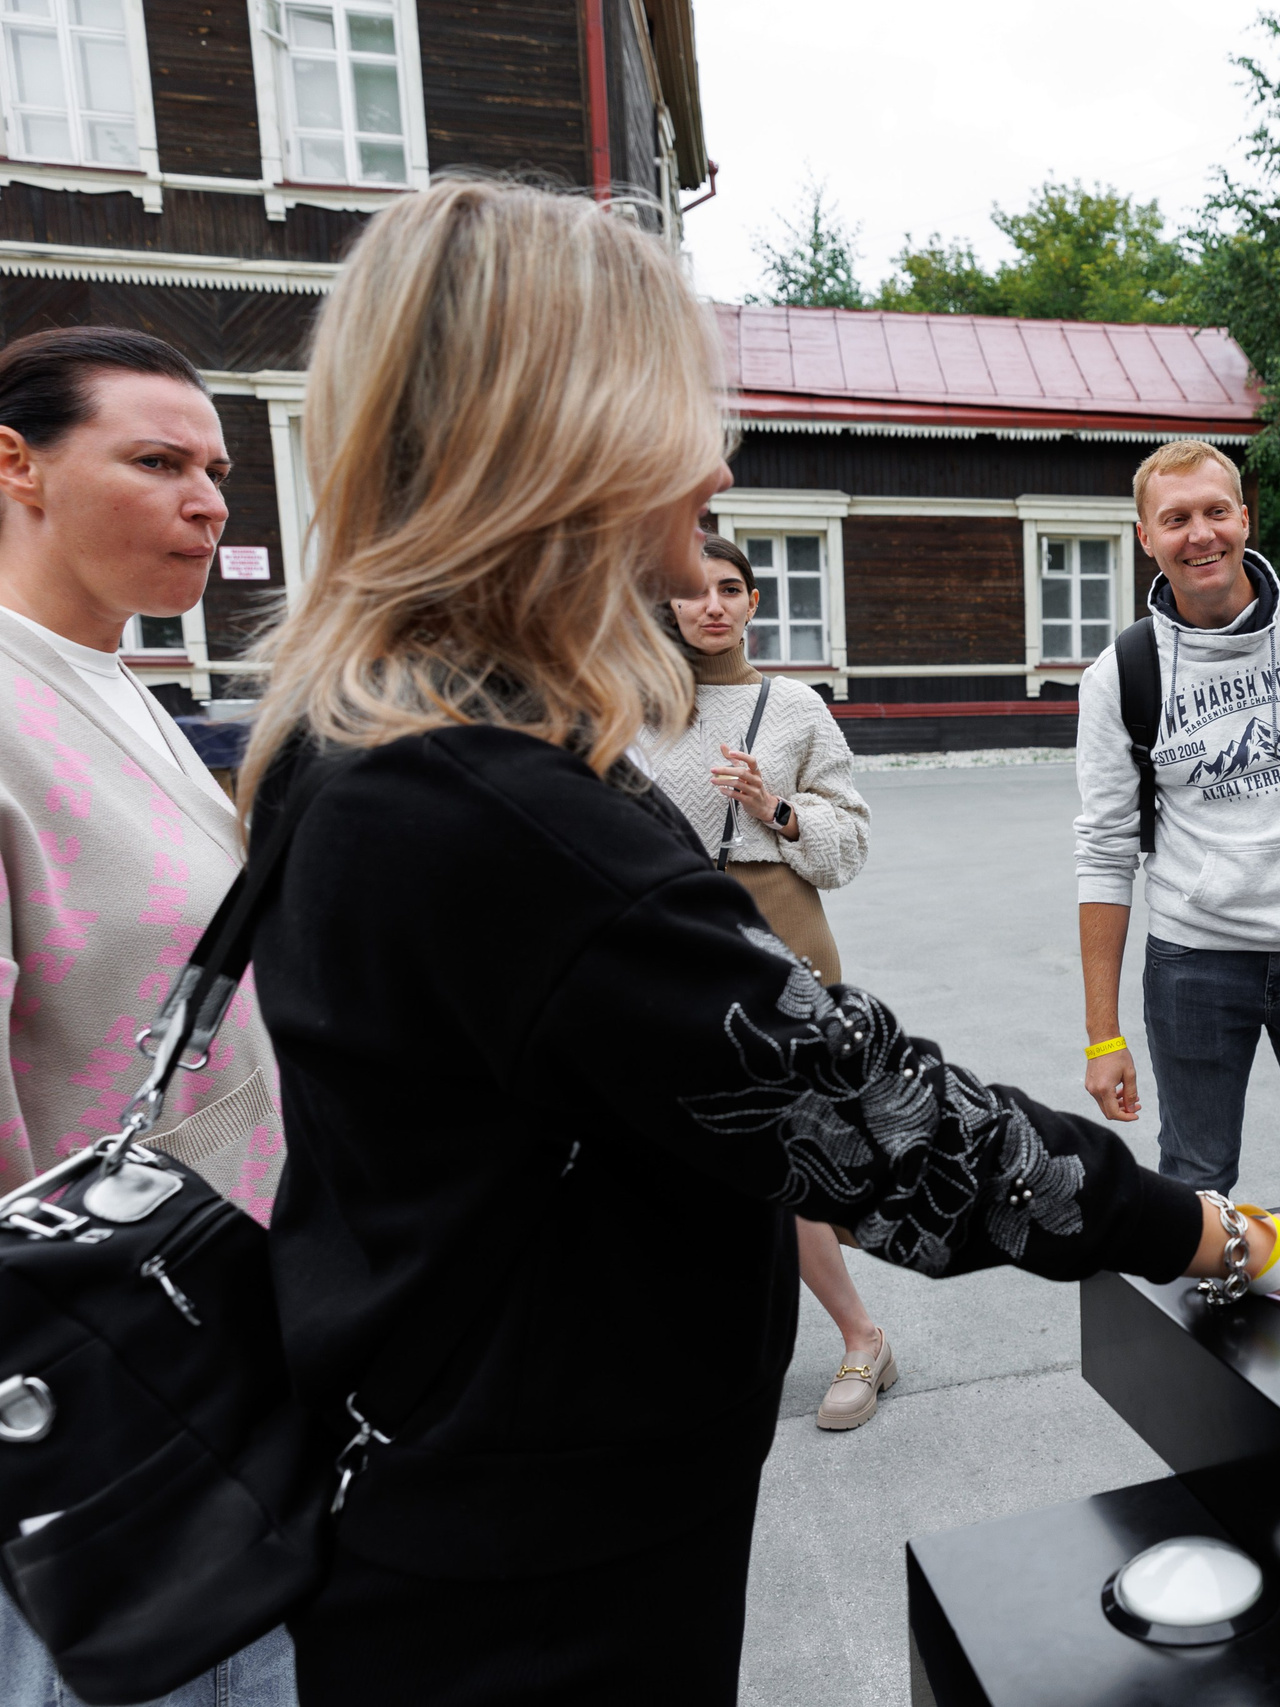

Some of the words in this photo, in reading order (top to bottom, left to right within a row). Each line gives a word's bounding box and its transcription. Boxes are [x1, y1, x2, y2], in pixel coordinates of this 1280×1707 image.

[1160, 694, 1189, 746] HE
[1193, 674, 1257, 718] HARSH
[1185, 704, 1234, 735] HARDENING
[1236, 699, 1248, 709] OF
[1154, 748, 1177, 764] ESTD
[1178, 739, 1206, 759] 2004
[1202, 780, 1241, 802] ALTAI
